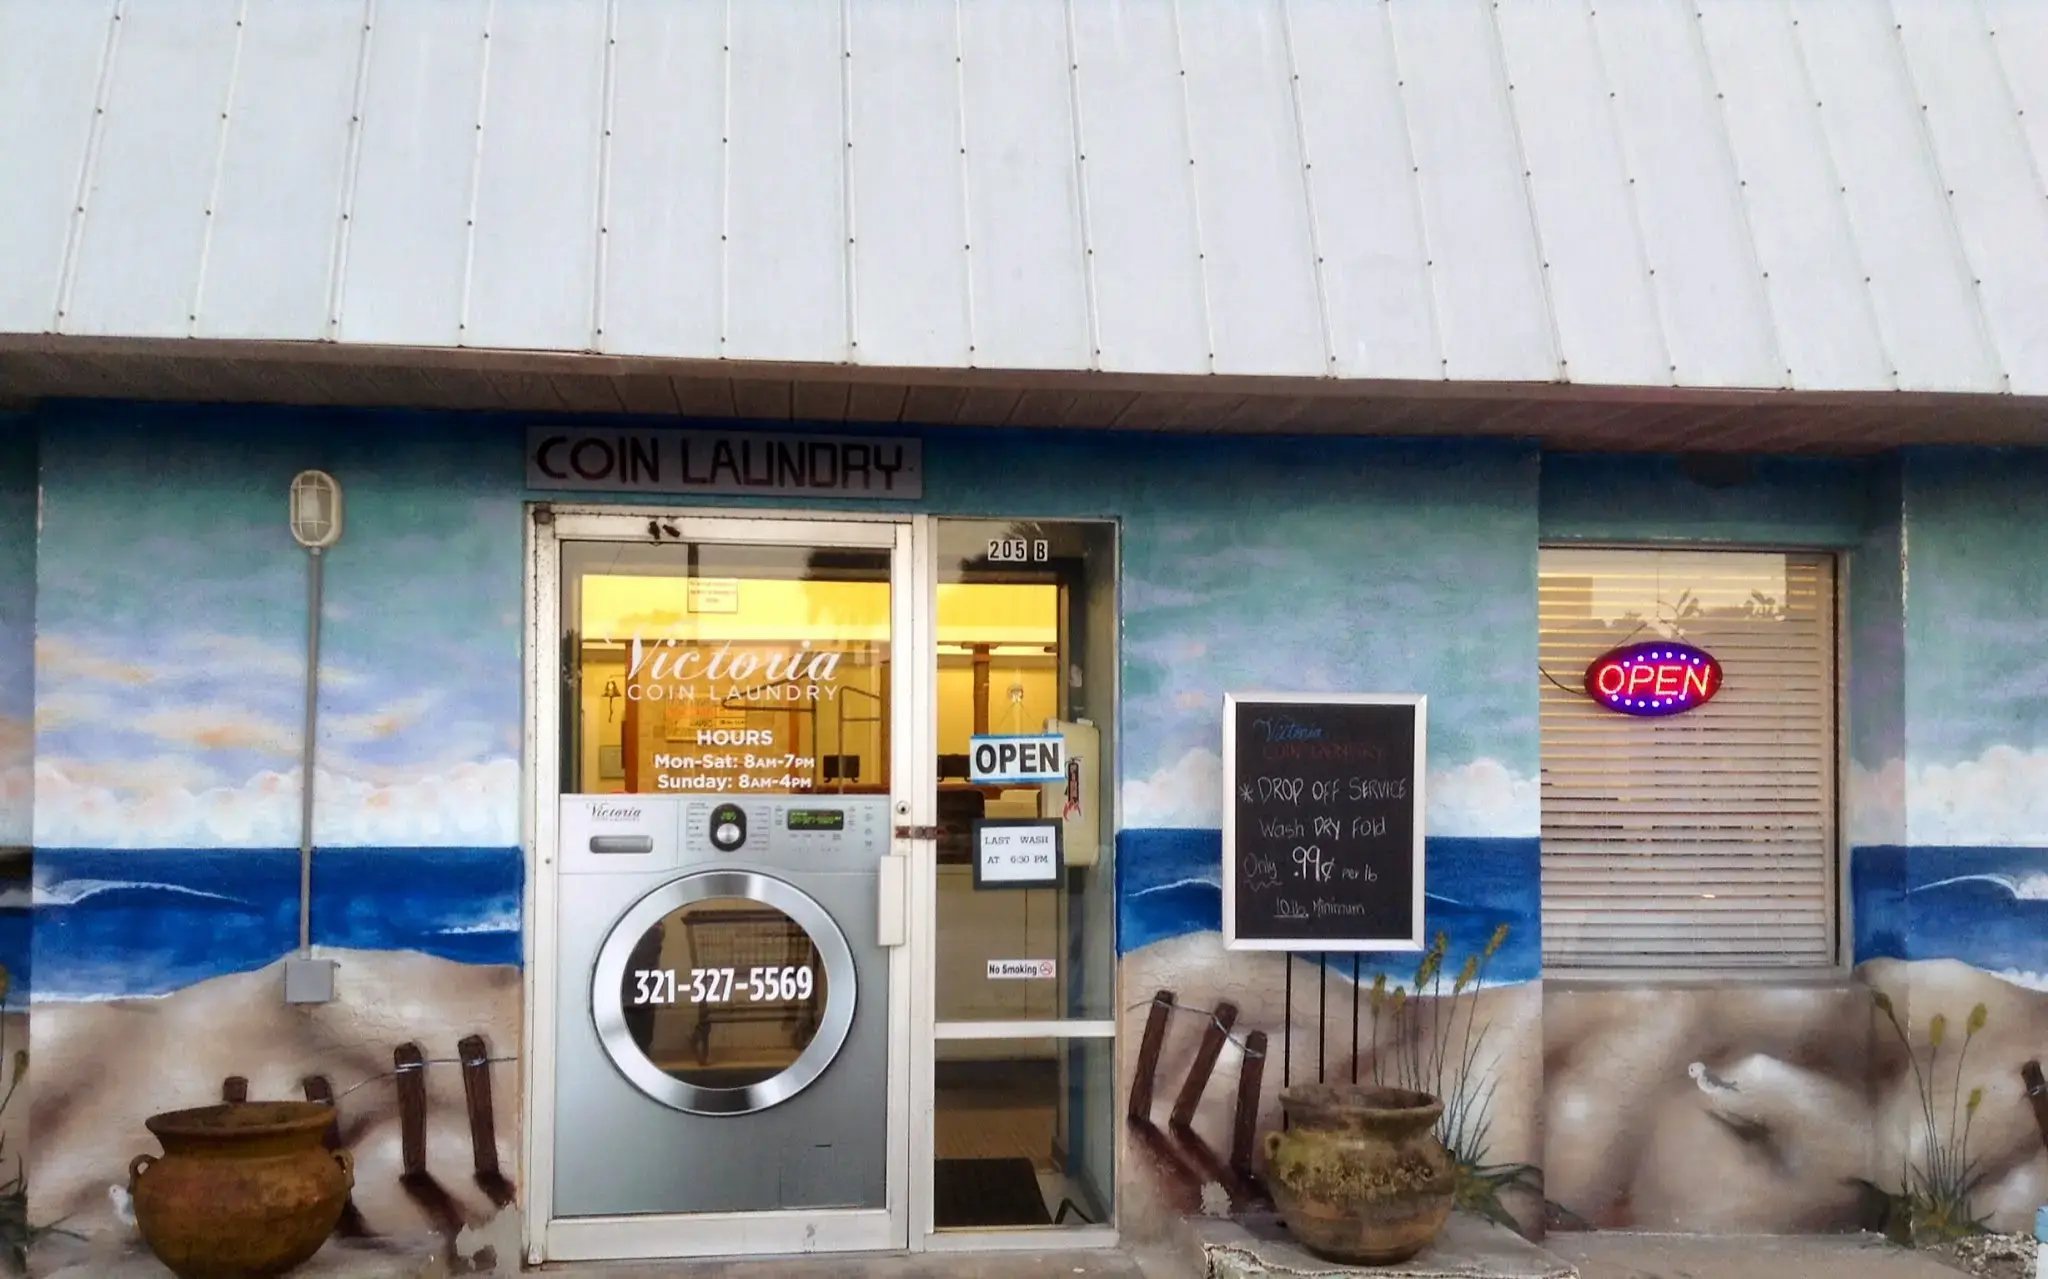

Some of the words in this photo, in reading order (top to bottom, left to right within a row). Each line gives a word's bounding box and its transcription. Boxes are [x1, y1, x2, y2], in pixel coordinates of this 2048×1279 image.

[537, 435, 660, 484] COIN
[680, 438, 904, 491] LAUNDRY
[989, 540, 1026, 560] 205
[1036, 541, 1047, 560] B
[606, 630, 842, 681] Victoria
[1598, 664, 1711, 697] OPEN
[627, 684, 695, 701] COIN
[709, 685, 839, 701] LAUNDRY
[696, 729, 774, 746] HOURS
[654, 753, 738, 769] Mon-Sat:
[743, 754, 816, 769] 8AM-7PM
[975, 742, 1060, 774] OPEN
[657, 774, 733, 791] Sunday:
[738, 774, 813, 789] 8AM-4PM
[1257, 776, 1304, 806] DROP
[1311, 778, 1341, 804] OFF
[1349, 777, 1407, 801] SERVICE
[586, 801, 641, 818] Victoria
[1259, 818, 1305, 839] Wash
[1314, 815, 1341, 841] DRY
[984, 836, 1011, 846] LAST
[1020, 835, 1049, 845] WASH
[987, 856, 1000, 864] AT
[1010, 856, 1030, 864] 6:30
[1034, 855, 1049, 864] PM
[1243, 852, 1278, 880] Only
[1313, 898, 1366, 918] Minimum
[989, 964, 1000, 974] No
[1002, 964, 1038, 976] Smoking
[633, 966, 814, 1004] 321-327-5569
